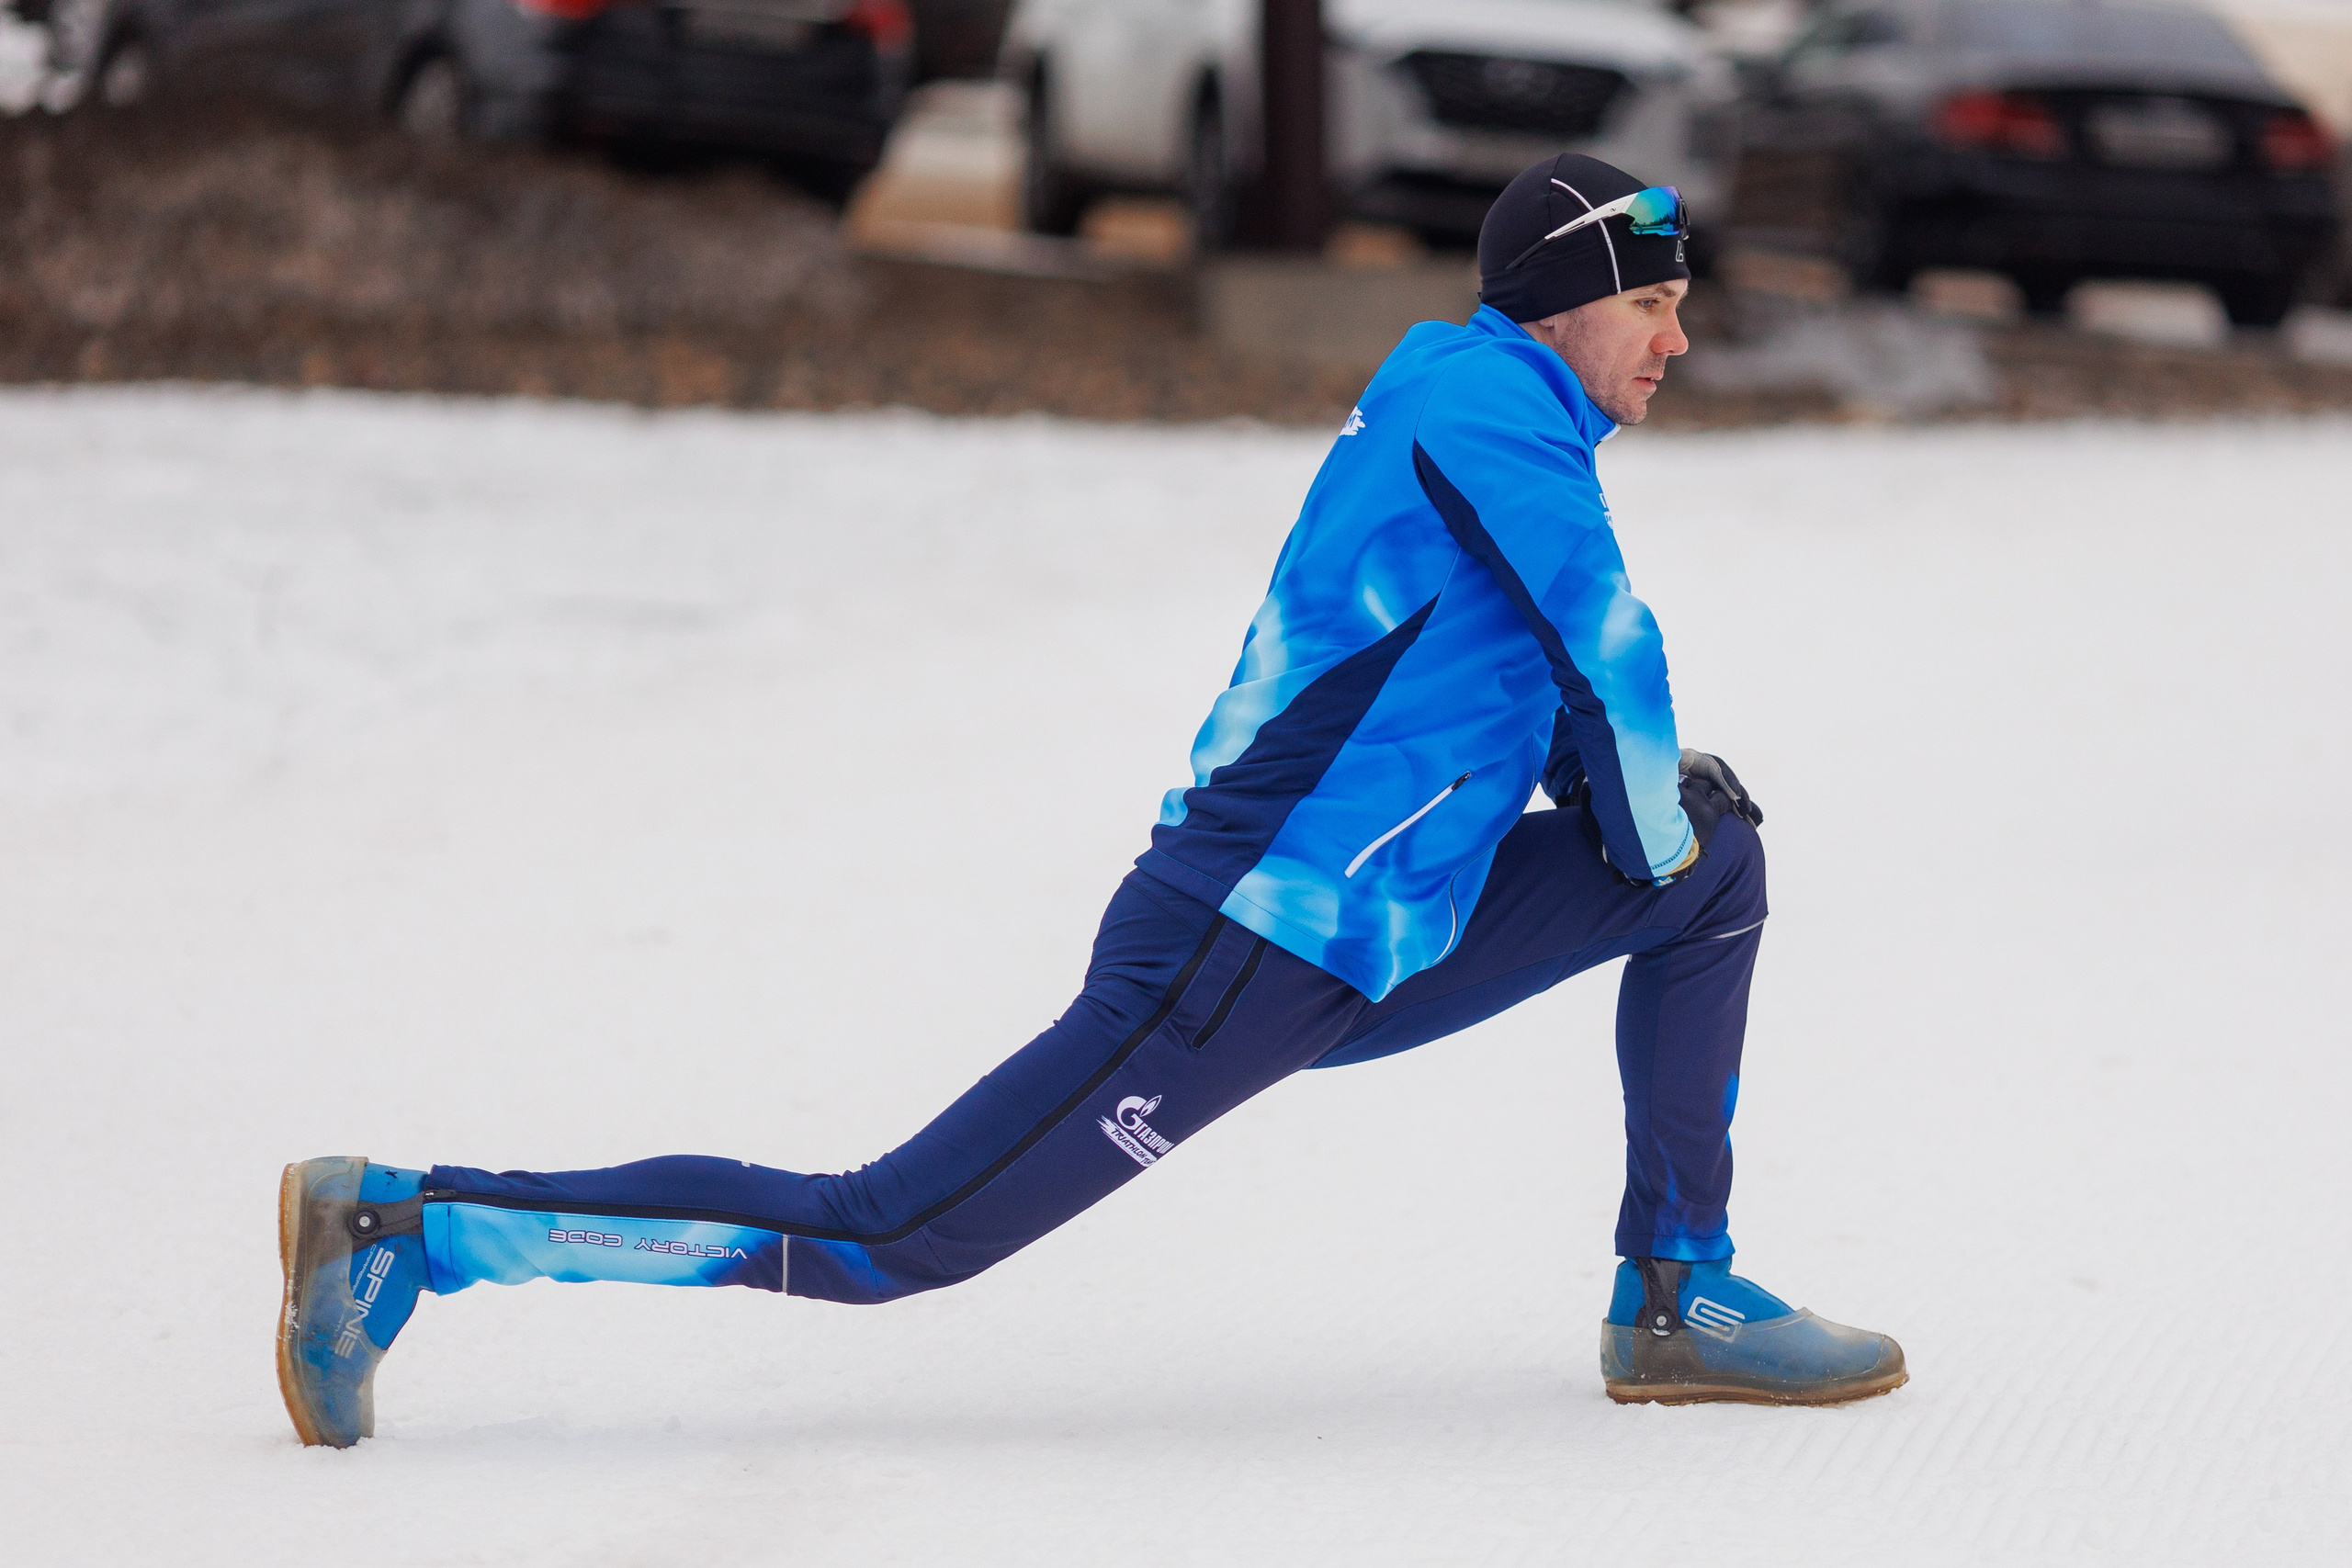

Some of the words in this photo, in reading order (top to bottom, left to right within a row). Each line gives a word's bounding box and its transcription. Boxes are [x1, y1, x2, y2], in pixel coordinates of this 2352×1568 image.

[548, 1228, 624, 1247] CODE
[634, 1237, 748, 1259] VICTORY
[334, 1247, 395, 1359] SPINE
